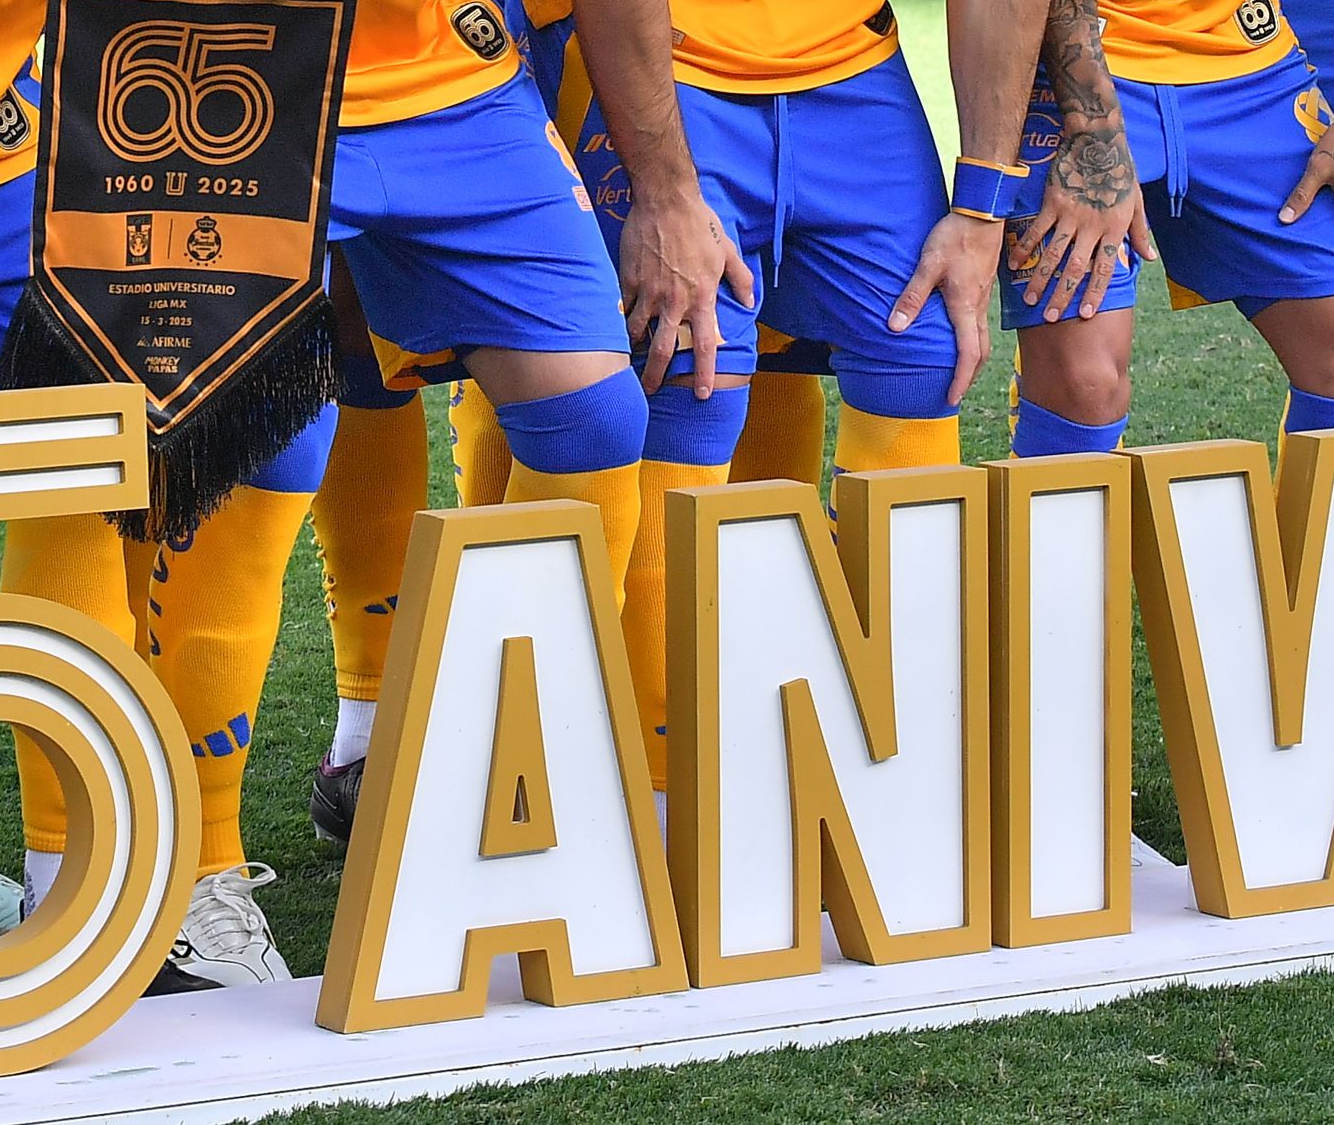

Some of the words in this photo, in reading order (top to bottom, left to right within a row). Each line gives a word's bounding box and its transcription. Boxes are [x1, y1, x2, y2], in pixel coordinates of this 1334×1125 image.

[459, 7, 496, 48] 65
[97, 19, 277, 165] 65
[104, 174, 154, 194] 1960
[165, 171, 188, 196] U
[198, 177, 260, 196] 2025
[596, 185, 633, 206] Vert
[109, 283, 152, 295] ESTADIO
[154, 281, 236, 295] UNIVERSITARIO
[148, 300, 168, 309] LIGA
[170, 299, 187, 309] MX
[140, 316, 150, 325] 15
[169, 316, 193, 326] 2025
[151, 336, 192, 349] AFIRME
[144, 355, 181, 366] MONKEY
[147, 365, 179, 374] PAPAS
